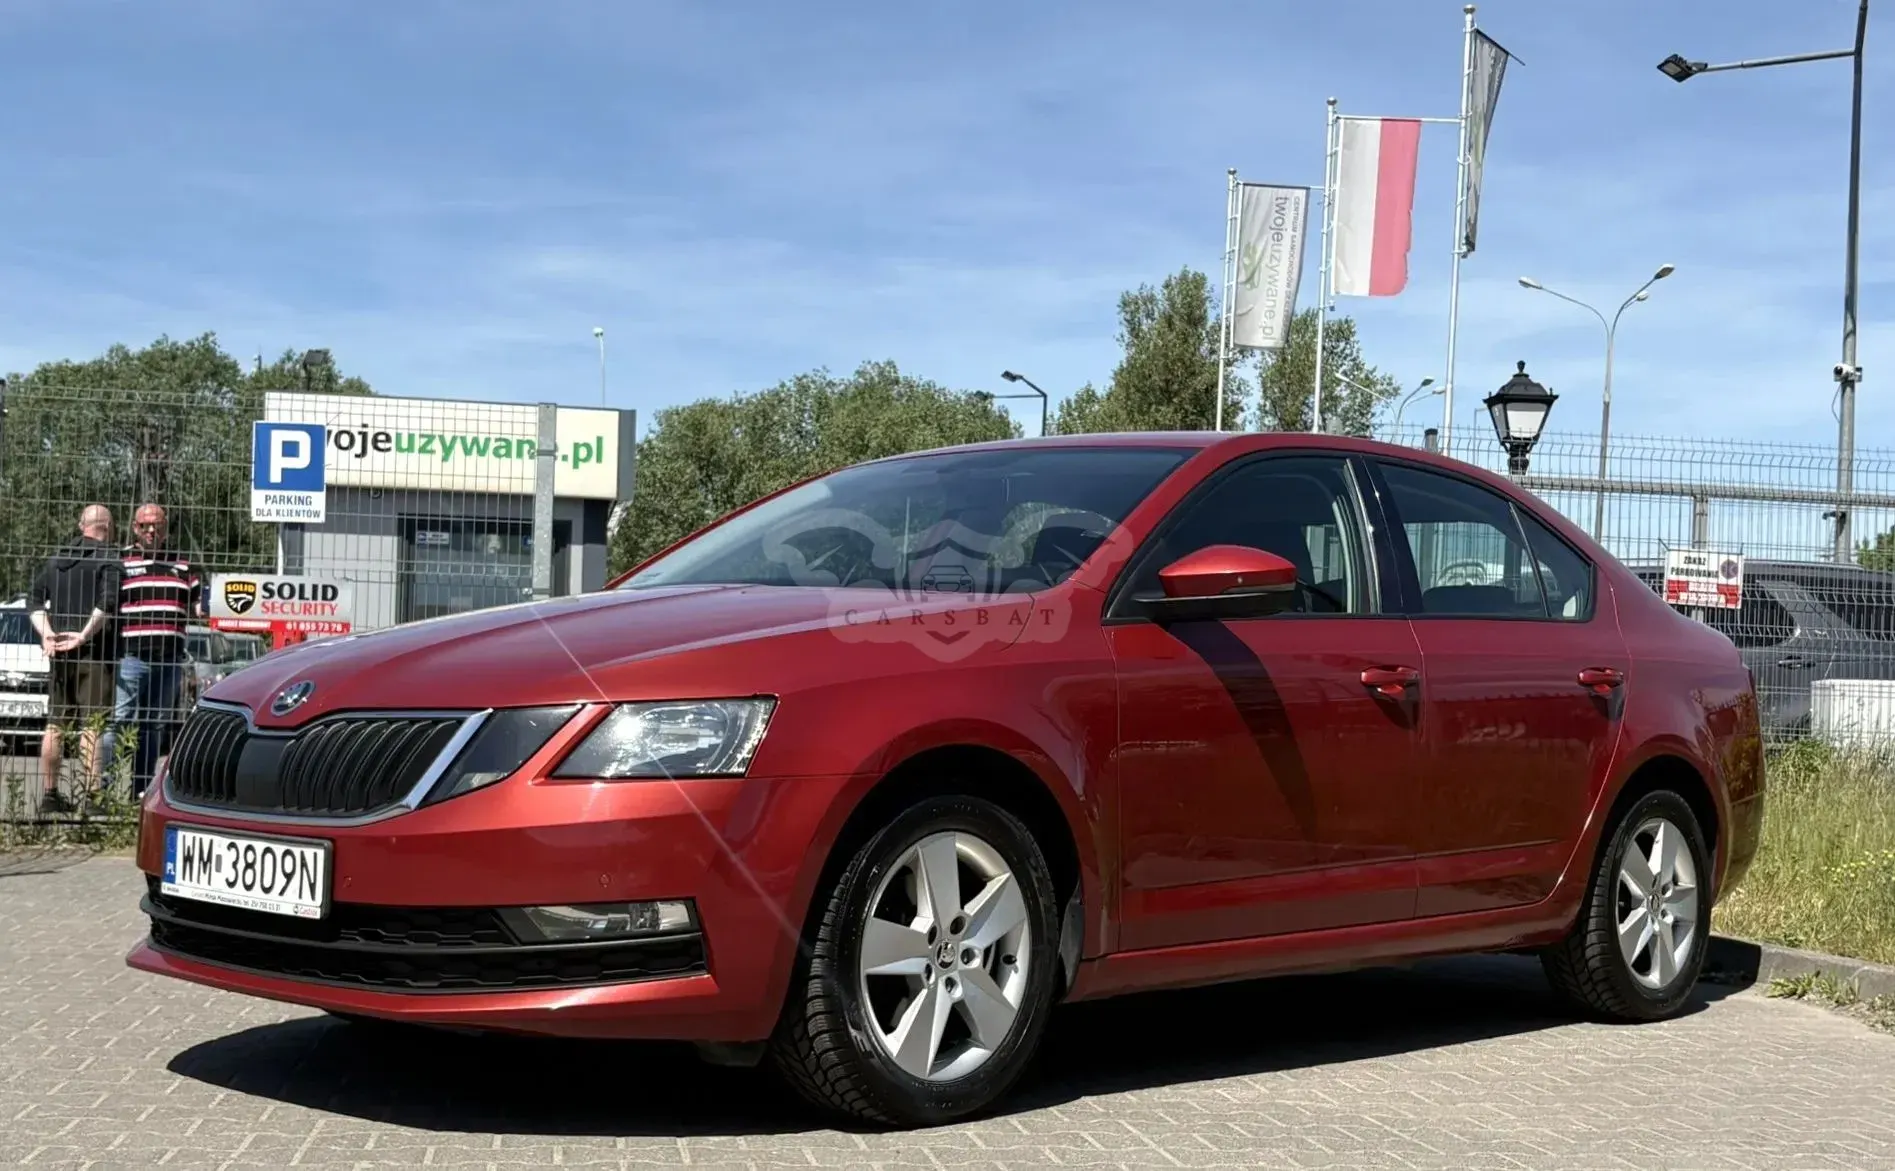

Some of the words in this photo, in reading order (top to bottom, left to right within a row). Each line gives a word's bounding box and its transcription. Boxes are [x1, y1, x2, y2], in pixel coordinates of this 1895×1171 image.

[1260, 196, 1290, 341] twojeuzywane.pl
[327, 423, 603, 469] ojeuzywan.pl
[270, 429, 311, 484] P
[264, 494, 313, 507] PARKING
[255, 508, 273, 517] DLA
[275, 508, 321, 518] KLIENTÓW
[226, 583, 256, 593] SOLID
[261, 581, 339, 602] SOLID
[261, 601, 339, 616] SECURITY
[165, 861, 176, 875] PL
[182, 834, 213, 886] WM
[225, 841, 318, 902] 3809N
